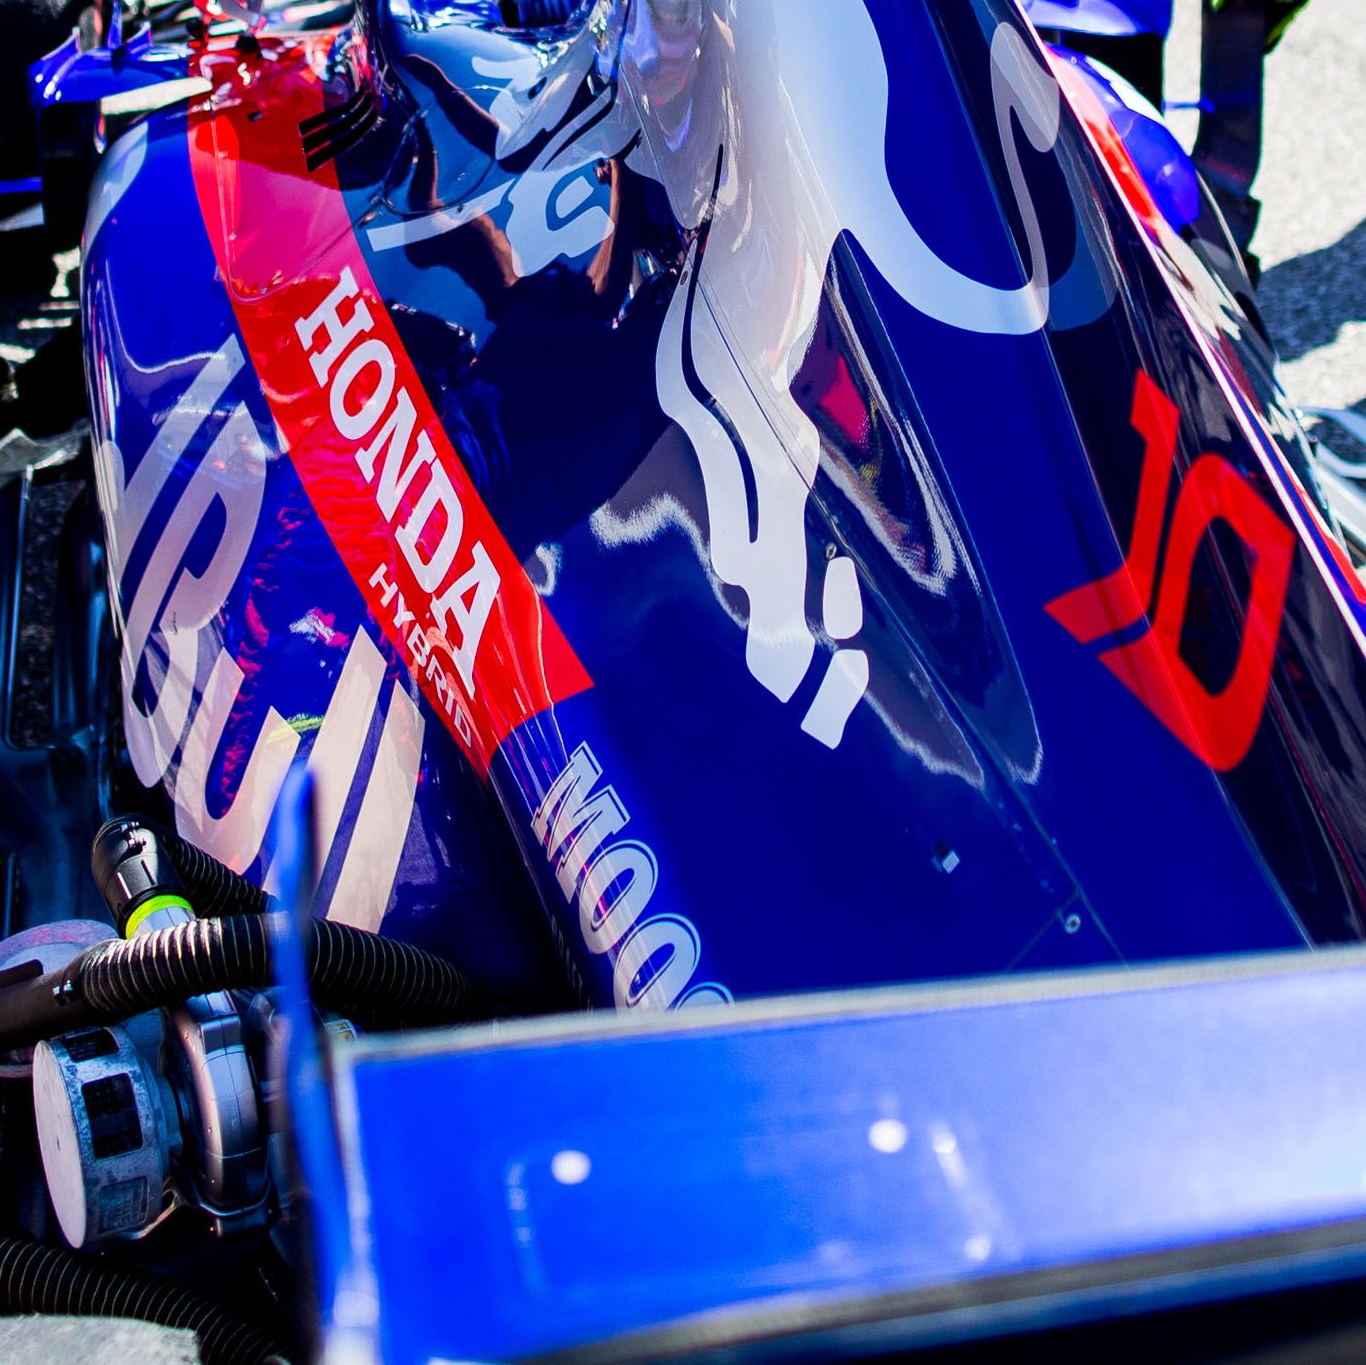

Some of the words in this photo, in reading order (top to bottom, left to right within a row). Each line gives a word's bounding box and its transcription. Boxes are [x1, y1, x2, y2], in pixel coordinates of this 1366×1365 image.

[295, 266, 501, 700] HONDA
[1043, 368, 1296, 772] 10
[369, 562, 473, 747] HYBRID
[531, 740, 734, 1014] MOO
